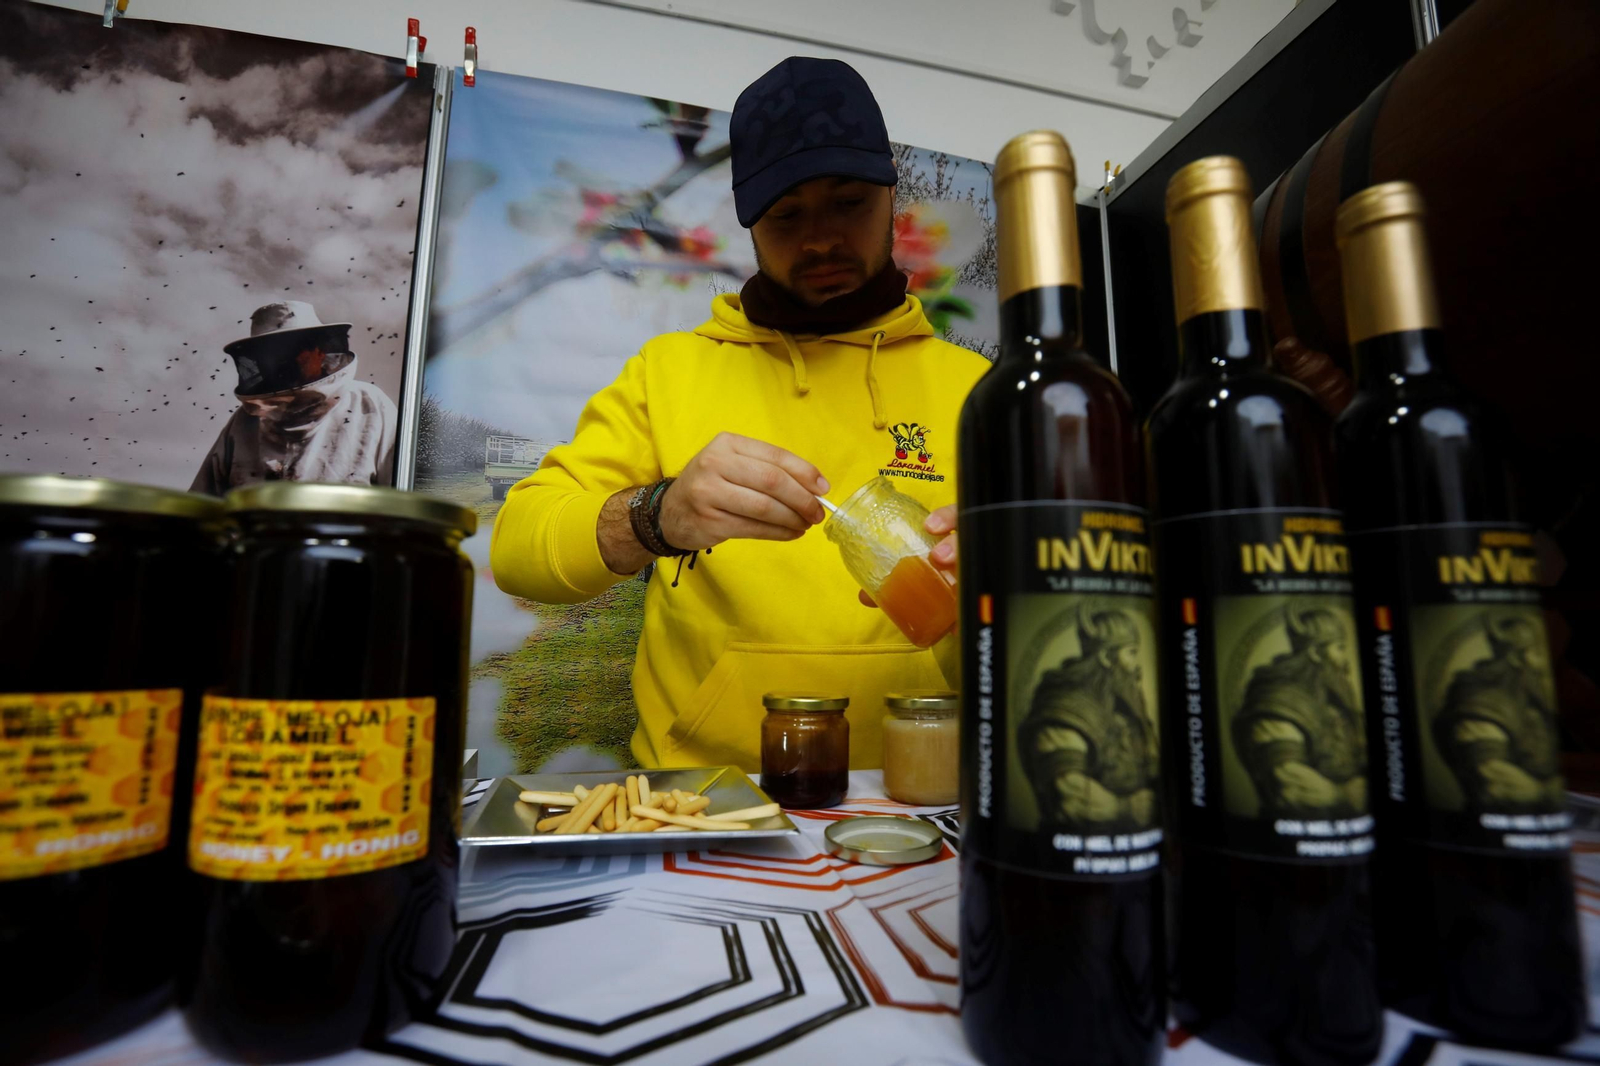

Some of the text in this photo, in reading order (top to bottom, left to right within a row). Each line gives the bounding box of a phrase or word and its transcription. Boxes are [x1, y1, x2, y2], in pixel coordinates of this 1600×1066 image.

[977, 627, 993, 818] PRODUCTO DE ESPAÑA
[1187, 693, 1202, 715] DE
[1187, 717, 1207, 807] PRODUCTO
[322, 829, 420, 860] HONIG
